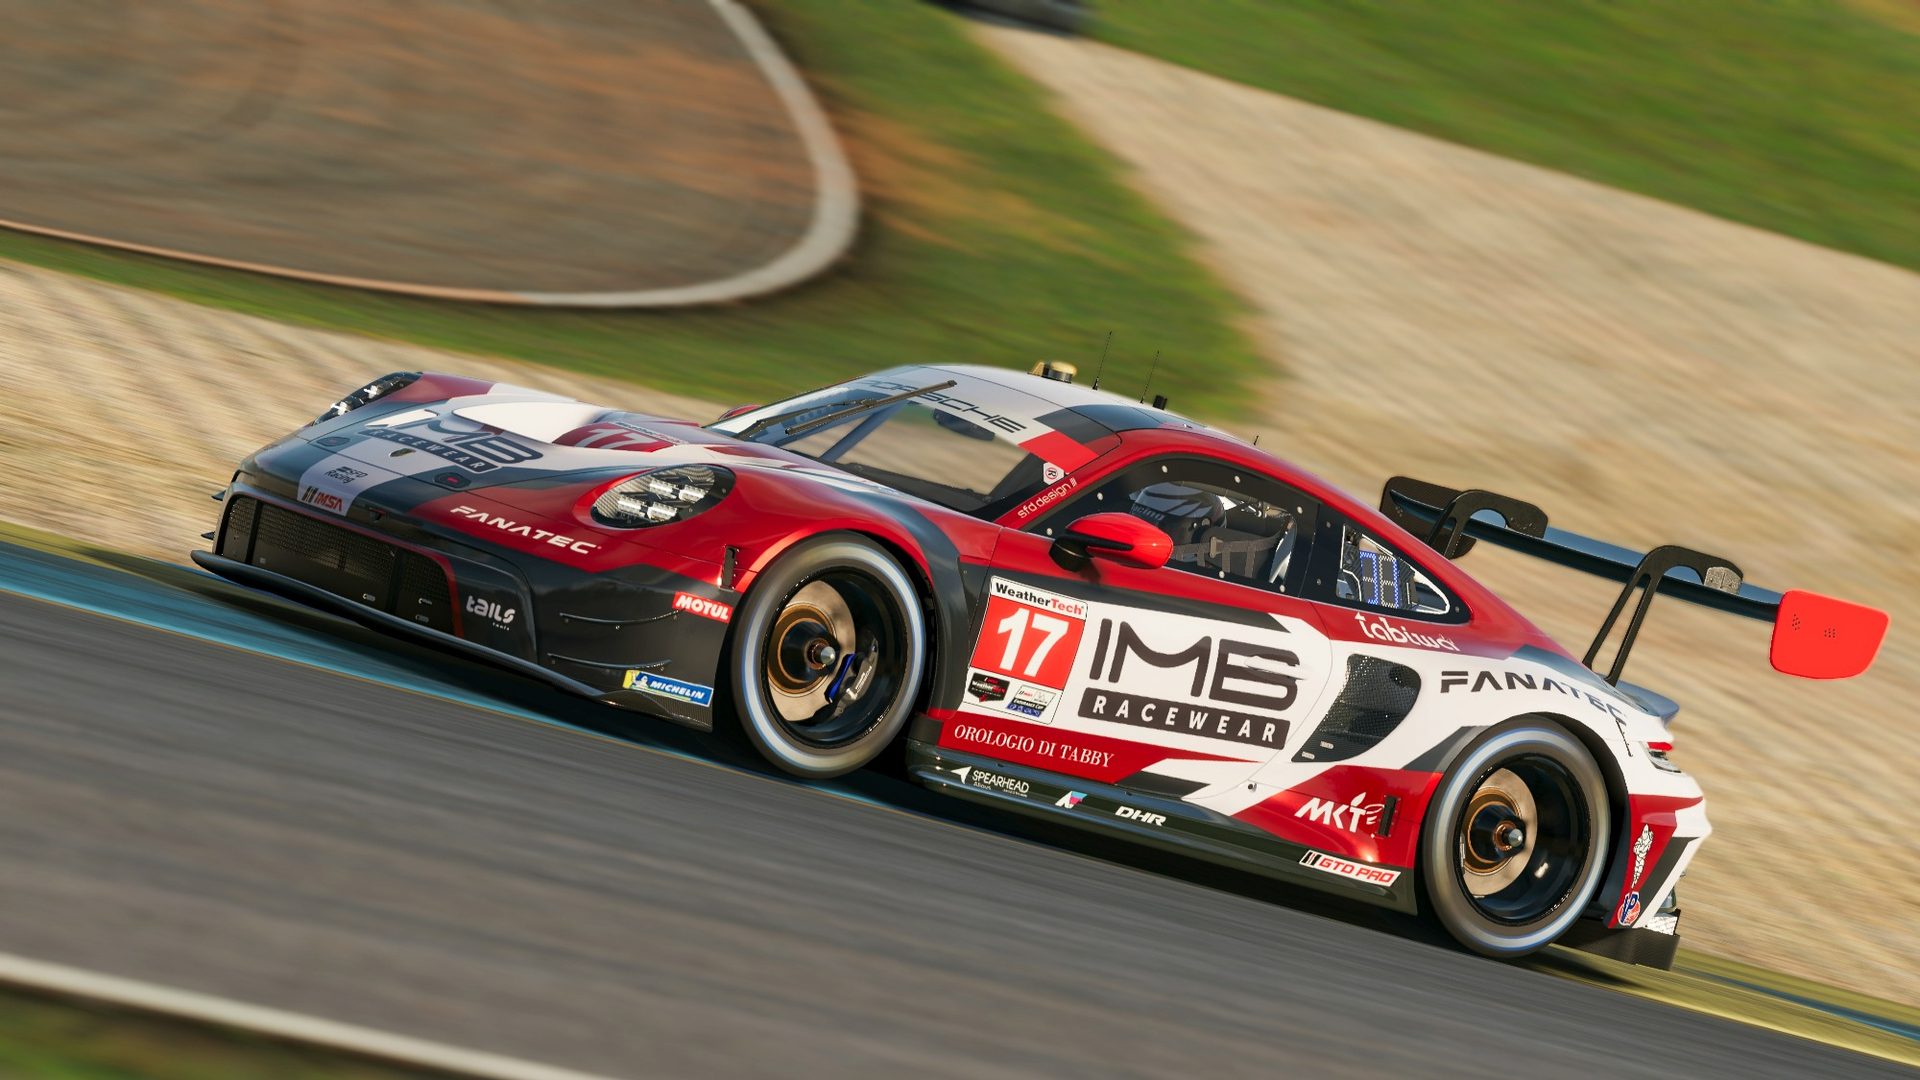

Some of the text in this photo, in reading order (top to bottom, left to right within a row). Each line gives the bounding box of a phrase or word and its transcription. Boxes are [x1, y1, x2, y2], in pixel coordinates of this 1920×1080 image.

[370, 428, 487, 469] RACEWEAR
[390, 414, 544, 464] MB
[314, 492, 342, 511] IMSA
[450, 505, 597, 555] FANATEC
[675, 594, 729, 620] MOTUL
[996, 582, 1085, 616] WeatherTech
[997, 607, 1070, 678] 17
[650, 680, 705, 699] MICHELIN
[1440, 670, 1627, 726] FANATEC
[1092, 695, 1277, 742] RACEWEAR
[954, 724, 1115, 768] OROLOGIO DI TABBY
[972, 770, 1029, 794] SPEARHEAD
[1115, 805, 1167, 826] DHR
[1319, 857, 1395, 883] GTD PRO
